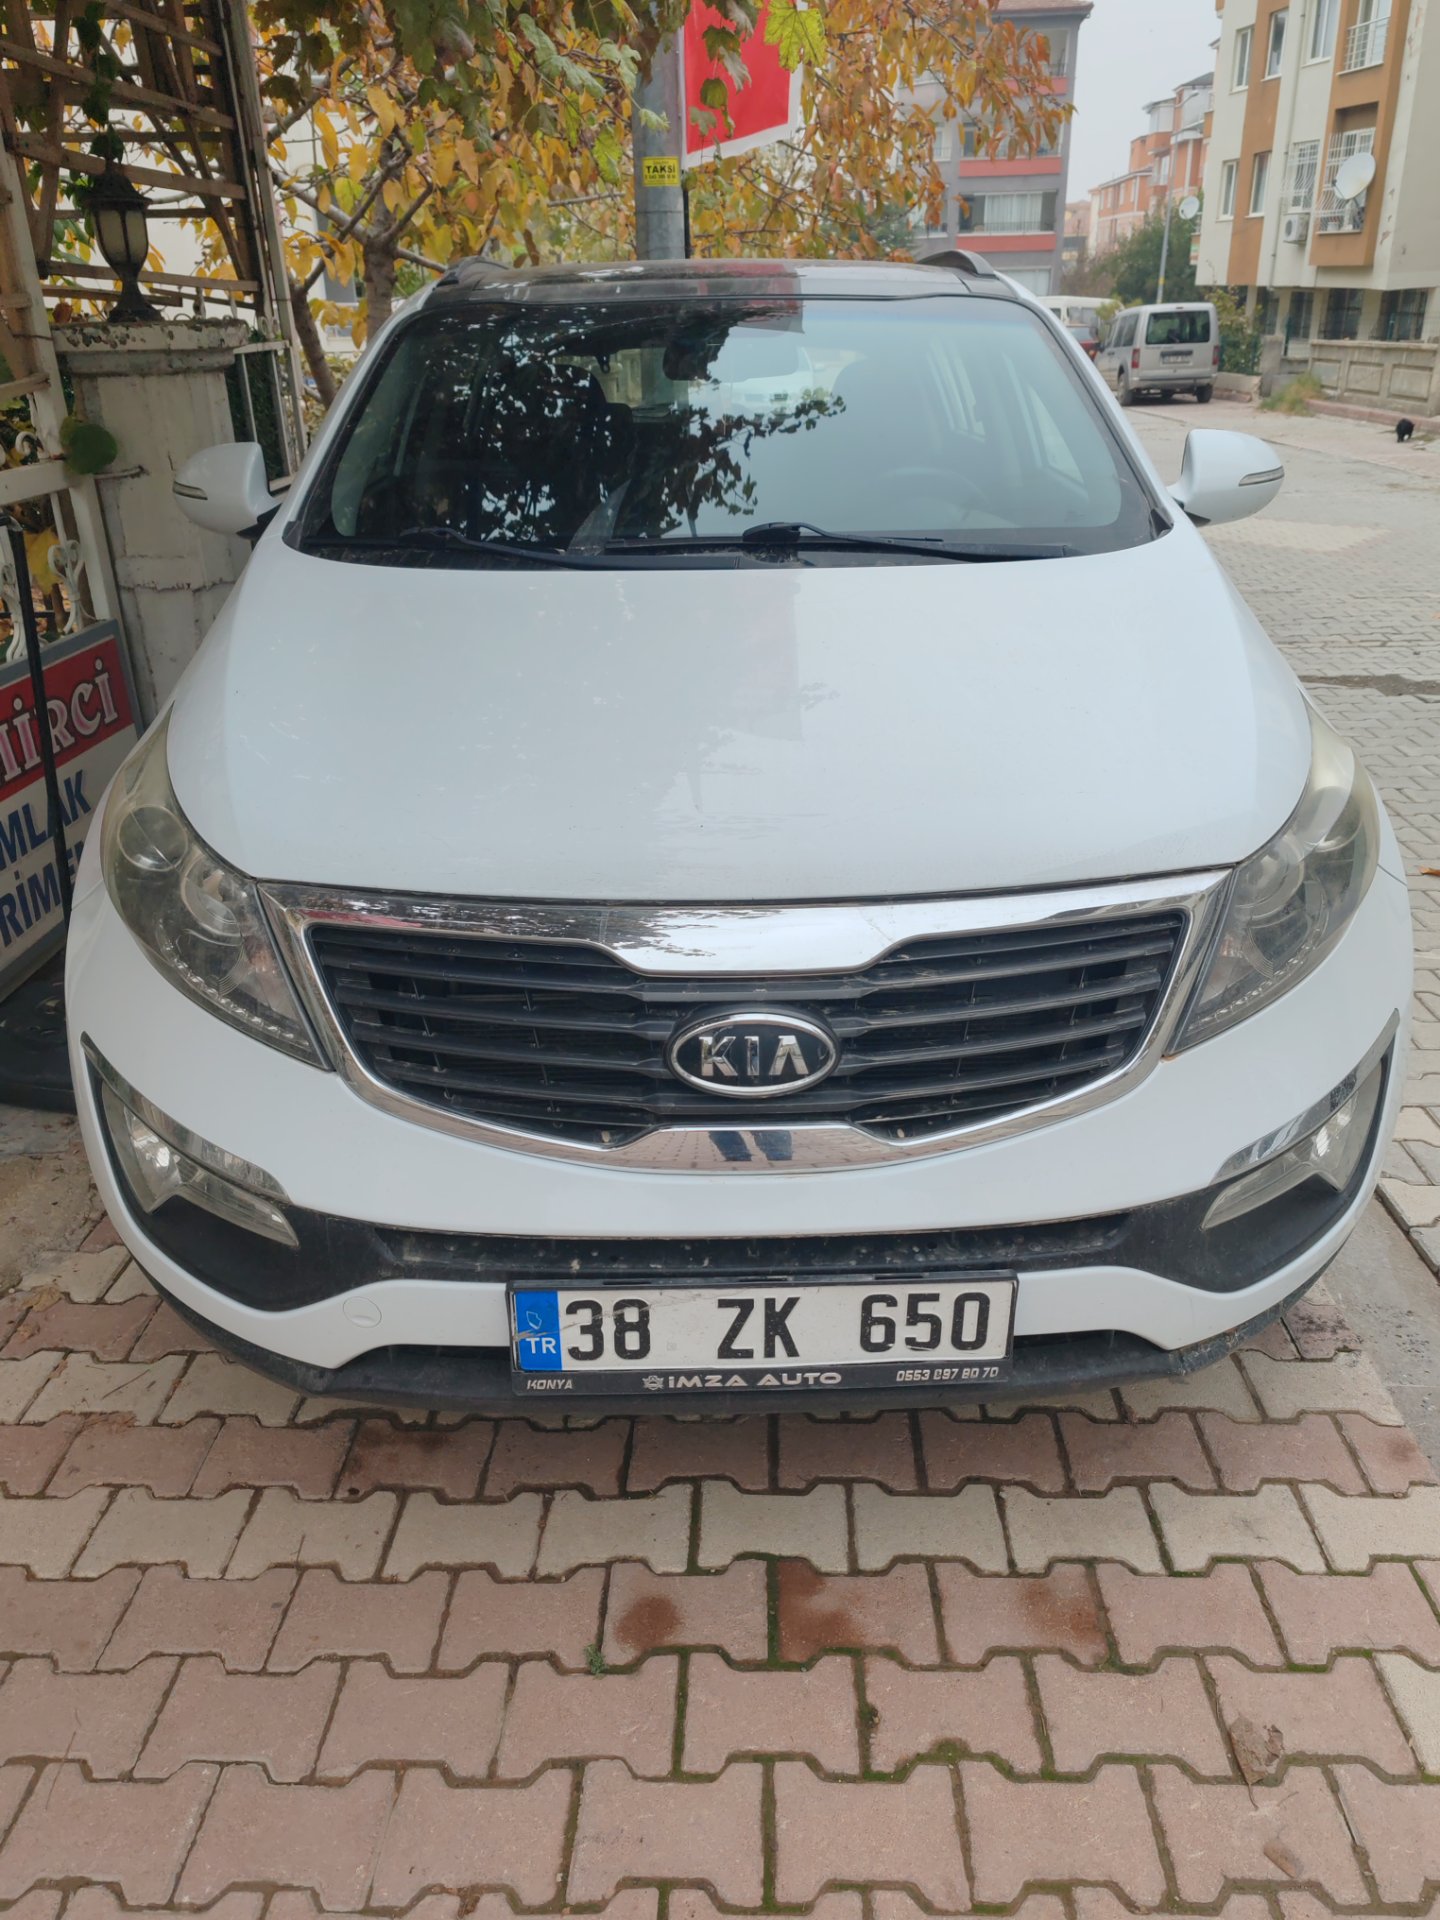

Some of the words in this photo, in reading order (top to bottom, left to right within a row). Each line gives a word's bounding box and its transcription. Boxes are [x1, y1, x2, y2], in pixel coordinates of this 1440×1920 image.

[646, 163, 676, 173] TAKSİ
[699, 1035, 809, 1076] KIA
[566, 1299, 651, 1361] 38
[717, 1297, 800, 1359] ZK
[860, 1292, 990, 1352] 650
[526, 1337, 557, 1354] TR
[756, 1372, 842, 1386] AUTO
[896, 1370, 931, 1382] 0553
[982, 1366, 999, 1378] 70
[527, 1379, 573, 1390] KONYA
